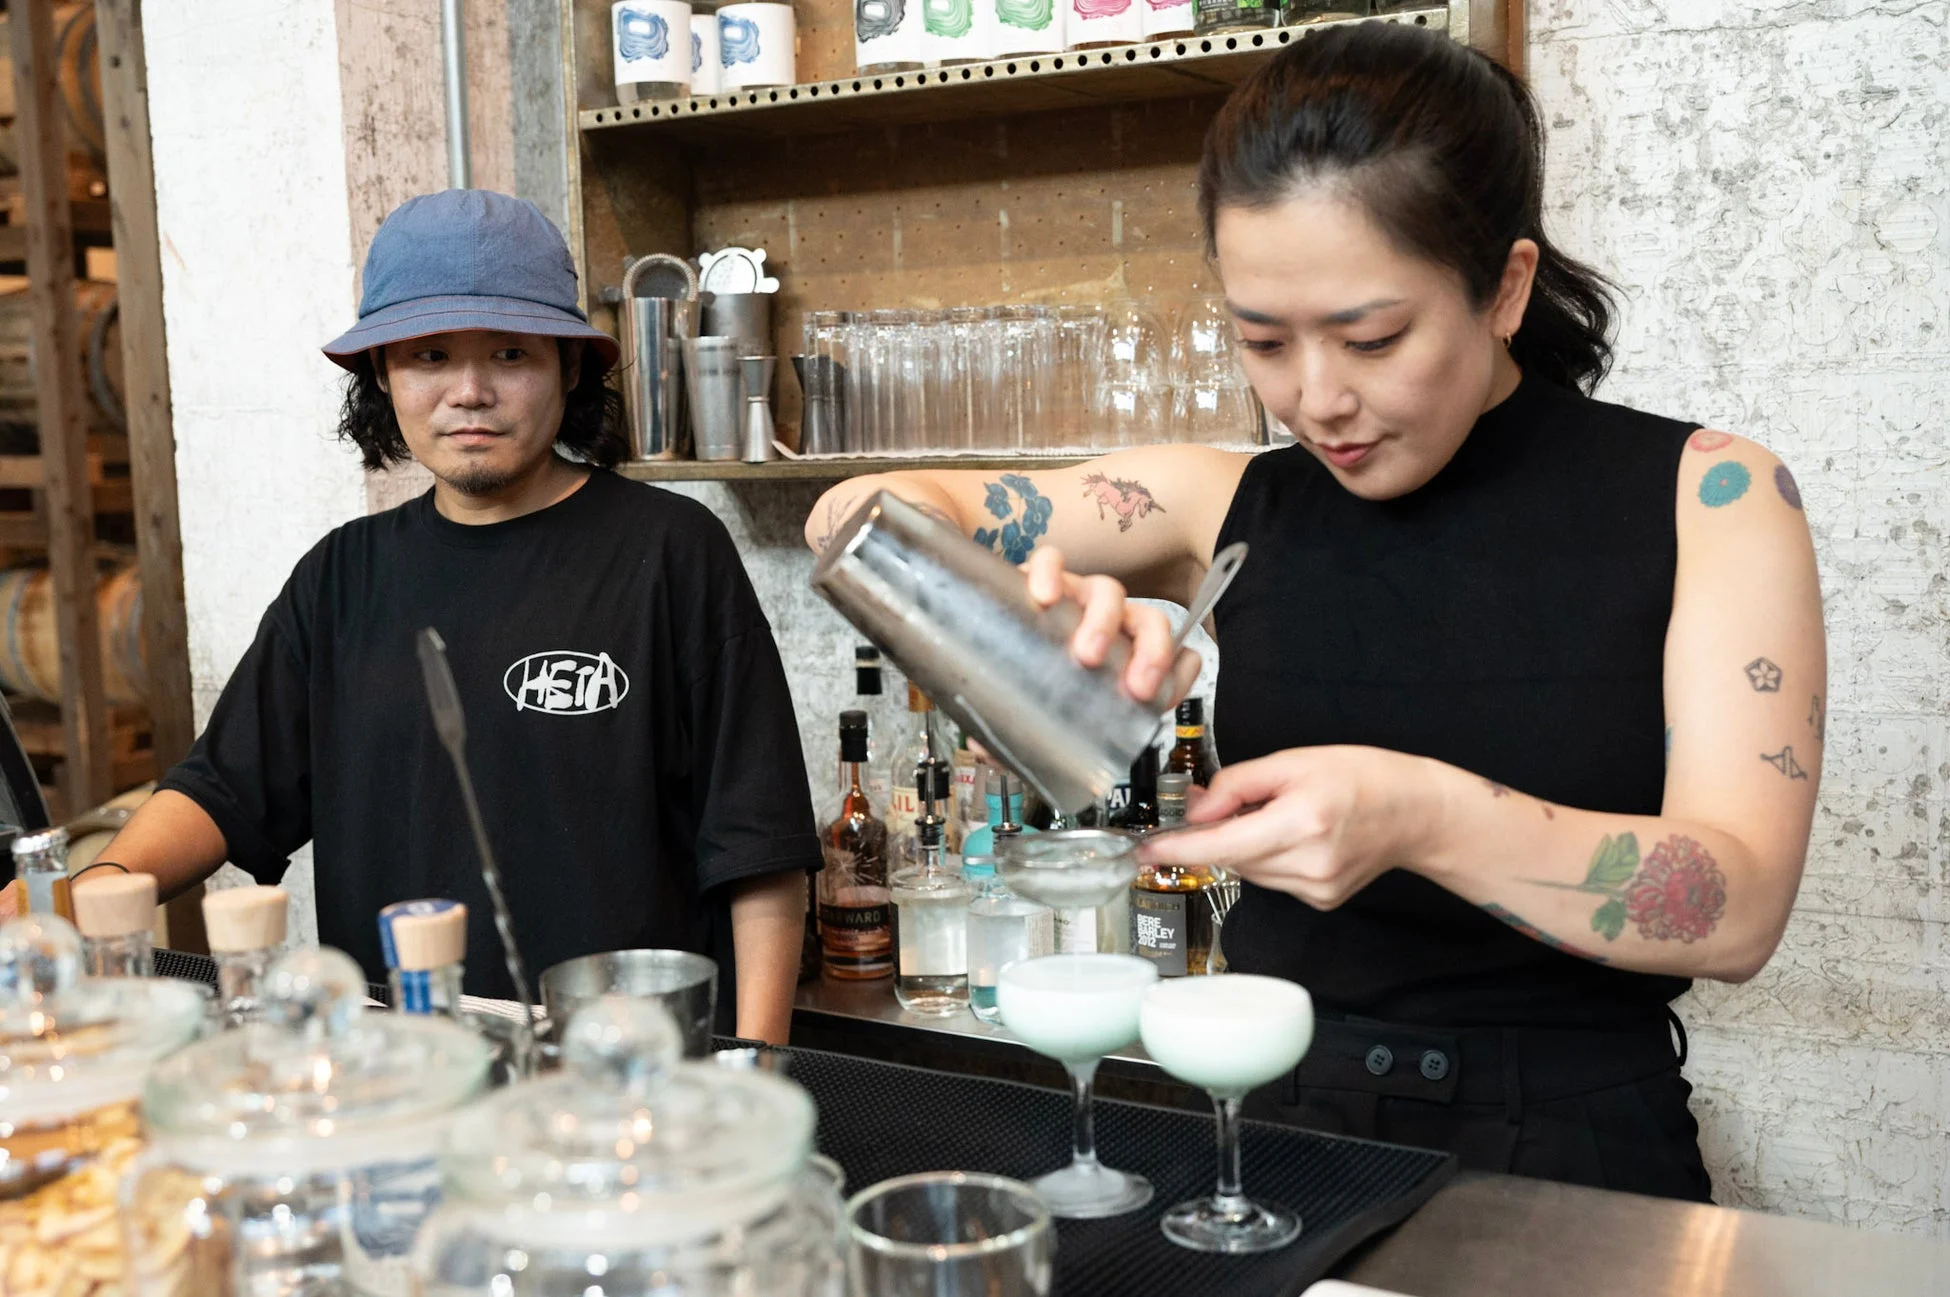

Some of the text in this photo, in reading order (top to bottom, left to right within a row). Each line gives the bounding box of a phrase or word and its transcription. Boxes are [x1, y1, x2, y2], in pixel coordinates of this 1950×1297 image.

[516, 652, 619, 712] HETA
[1137, 913, 1162, 928] BERE
[1138, 926, 1175, 940] BARLEY
[1138, 936, 1157, 948] 2012
